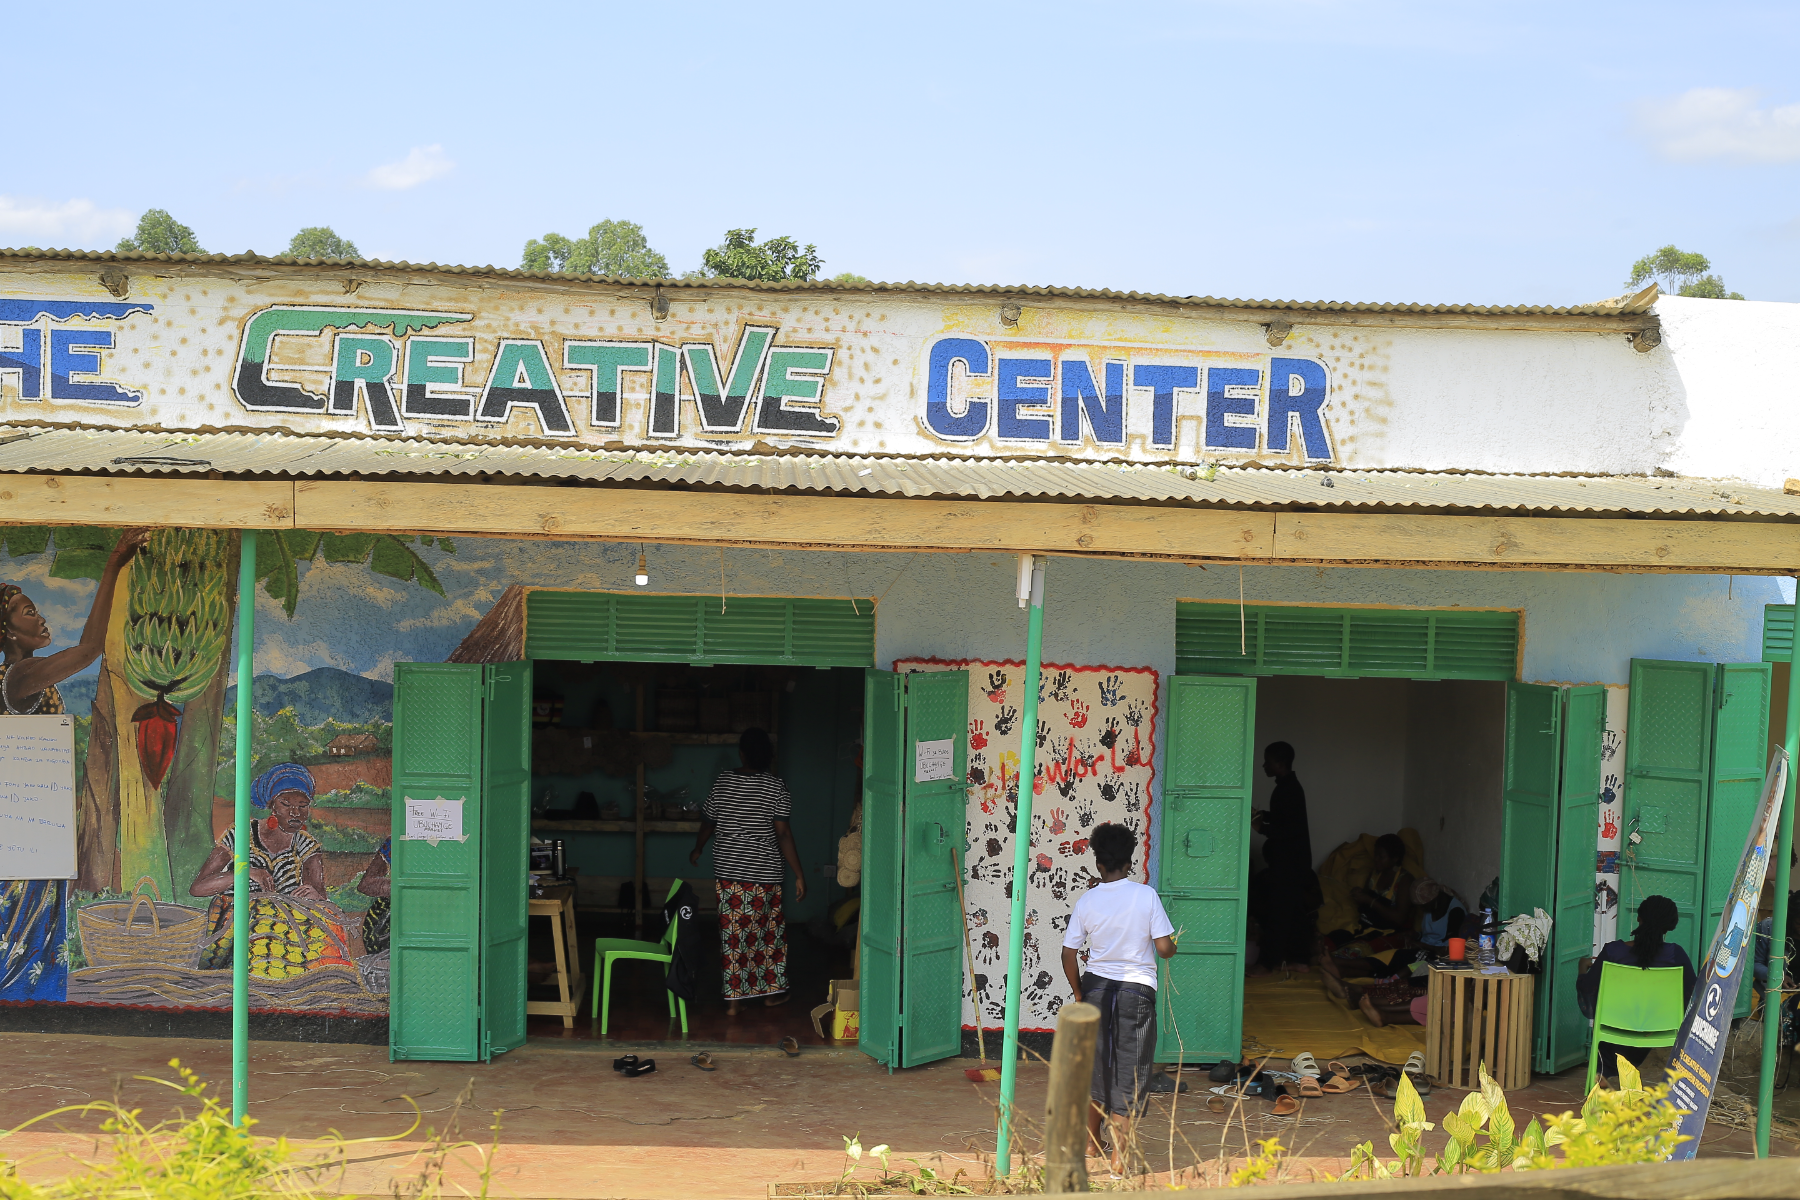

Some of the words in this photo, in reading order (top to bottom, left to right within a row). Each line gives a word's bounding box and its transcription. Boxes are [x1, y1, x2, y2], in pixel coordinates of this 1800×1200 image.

[0, 299, 154, 407] HE
[231, 304, 840, 438] CREATIVE
[924, 337, 1336, 464] CENTER
